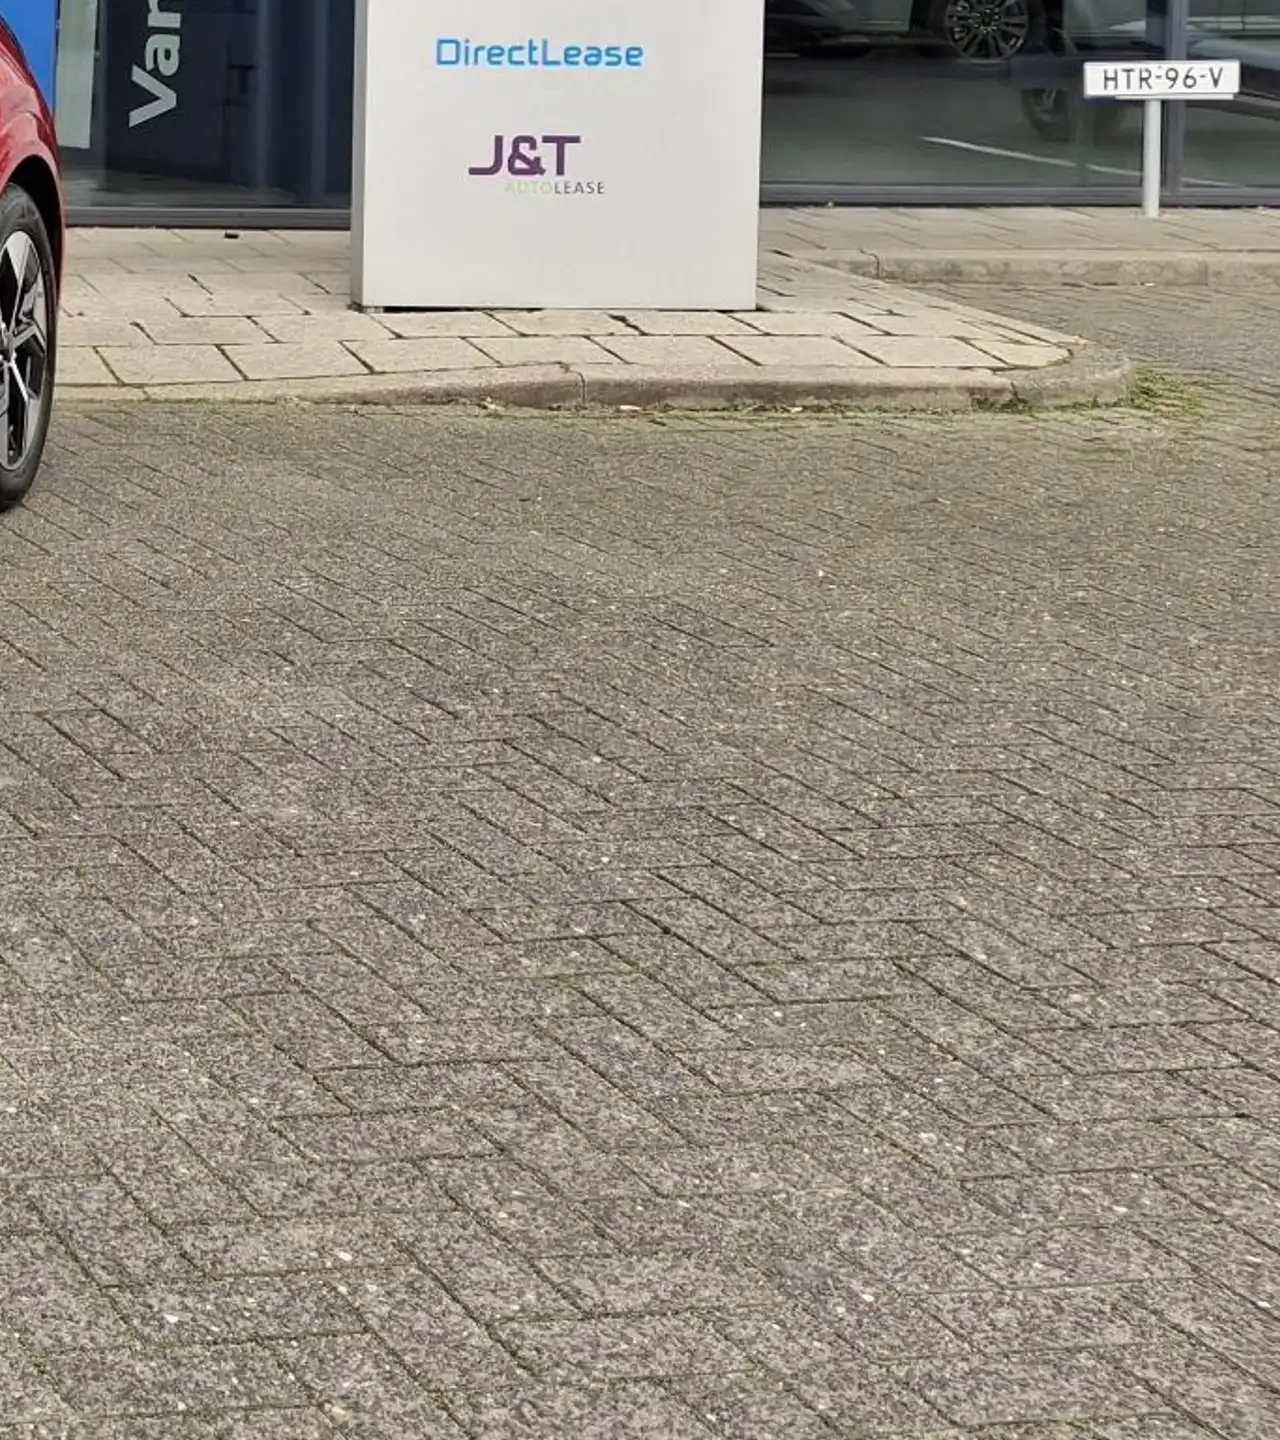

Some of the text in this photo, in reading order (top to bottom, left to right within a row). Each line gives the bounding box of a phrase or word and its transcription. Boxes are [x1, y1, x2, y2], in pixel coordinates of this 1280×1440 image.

[436, 38, 644, 67] DirectLease
[1103, 67, 1223, 90] HTR-96-V
[468, 135, 581, 176] J&T
